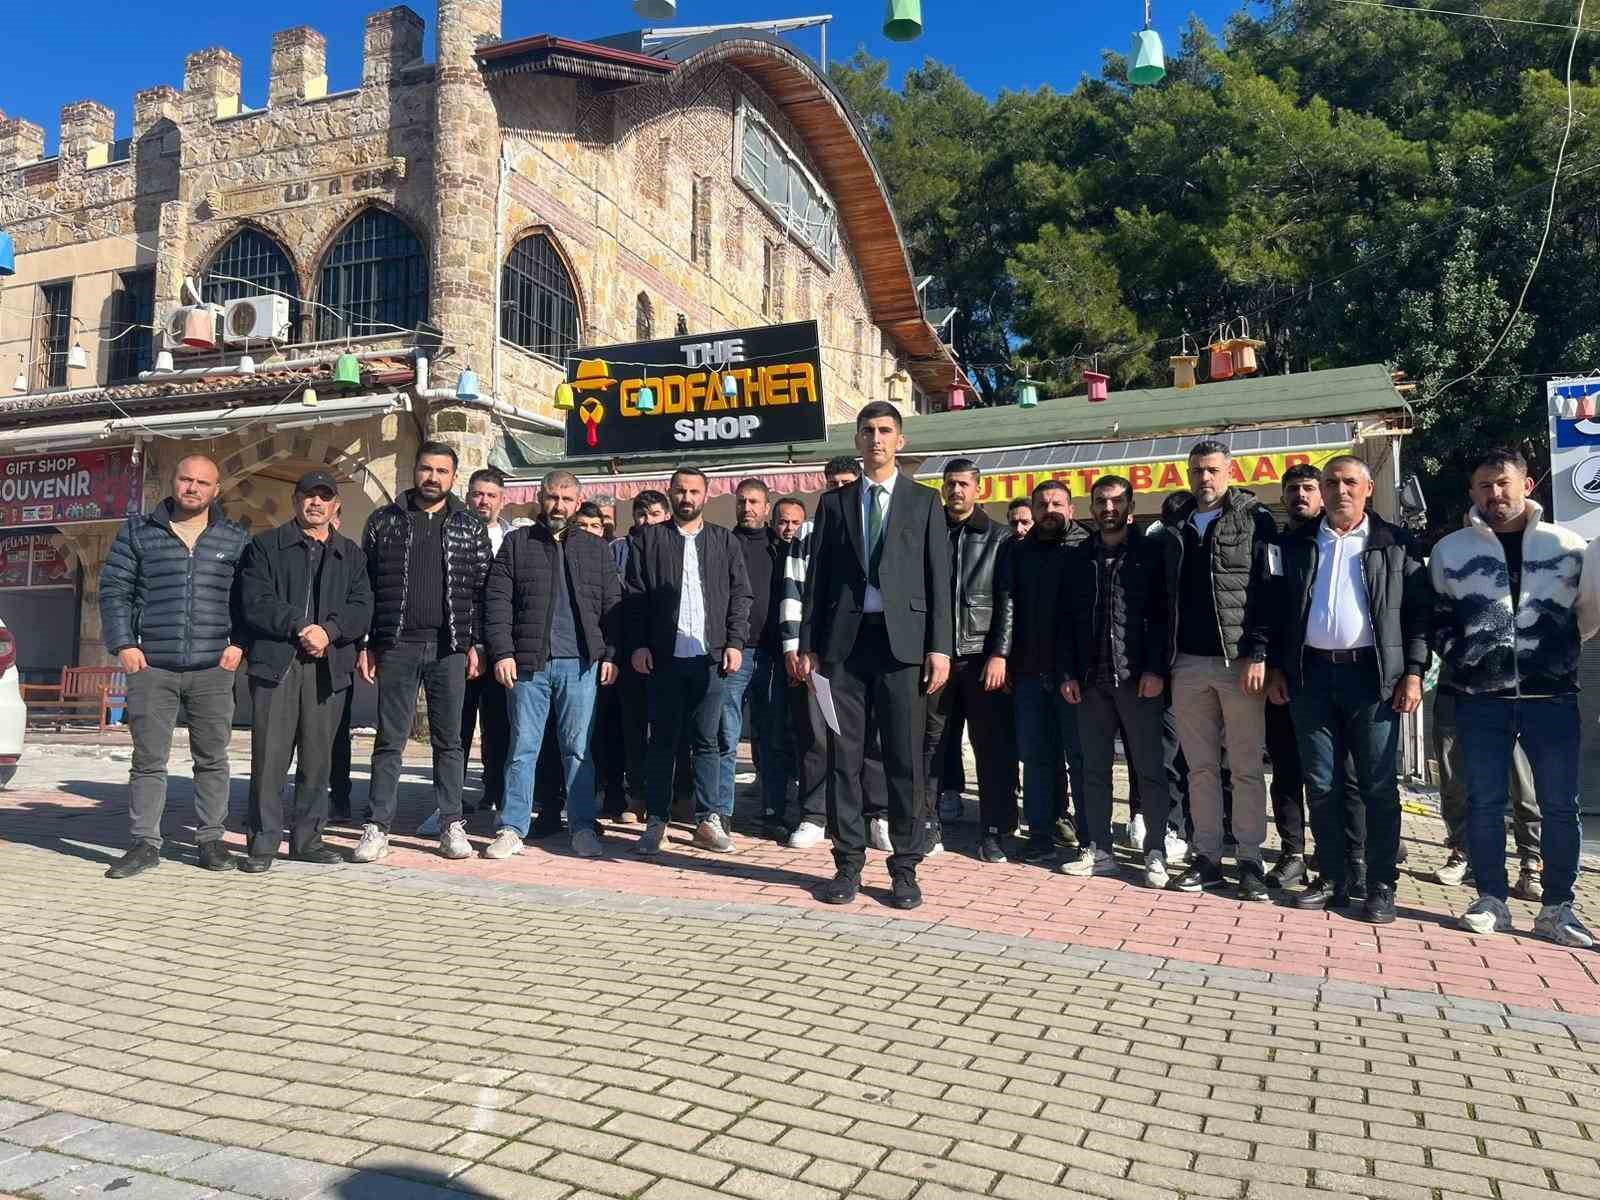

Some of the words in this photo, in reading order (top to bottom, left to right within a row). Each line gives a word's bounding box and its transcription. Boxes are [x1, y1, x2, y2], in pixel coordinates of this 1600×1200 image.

[680, 339, 745, 367] THE
[620, 363, 818, 417] GODFATHER
[674, 414, 760, 442] SHOP
[6, 460, 35, 475] GIFT
[38, 457, 77, 473] SHOP
[976, 469, 1101, 501] UTLT
[1129, 454, 1311, 490] BAAA
[0, 470, 90, 501] OUVENIR
